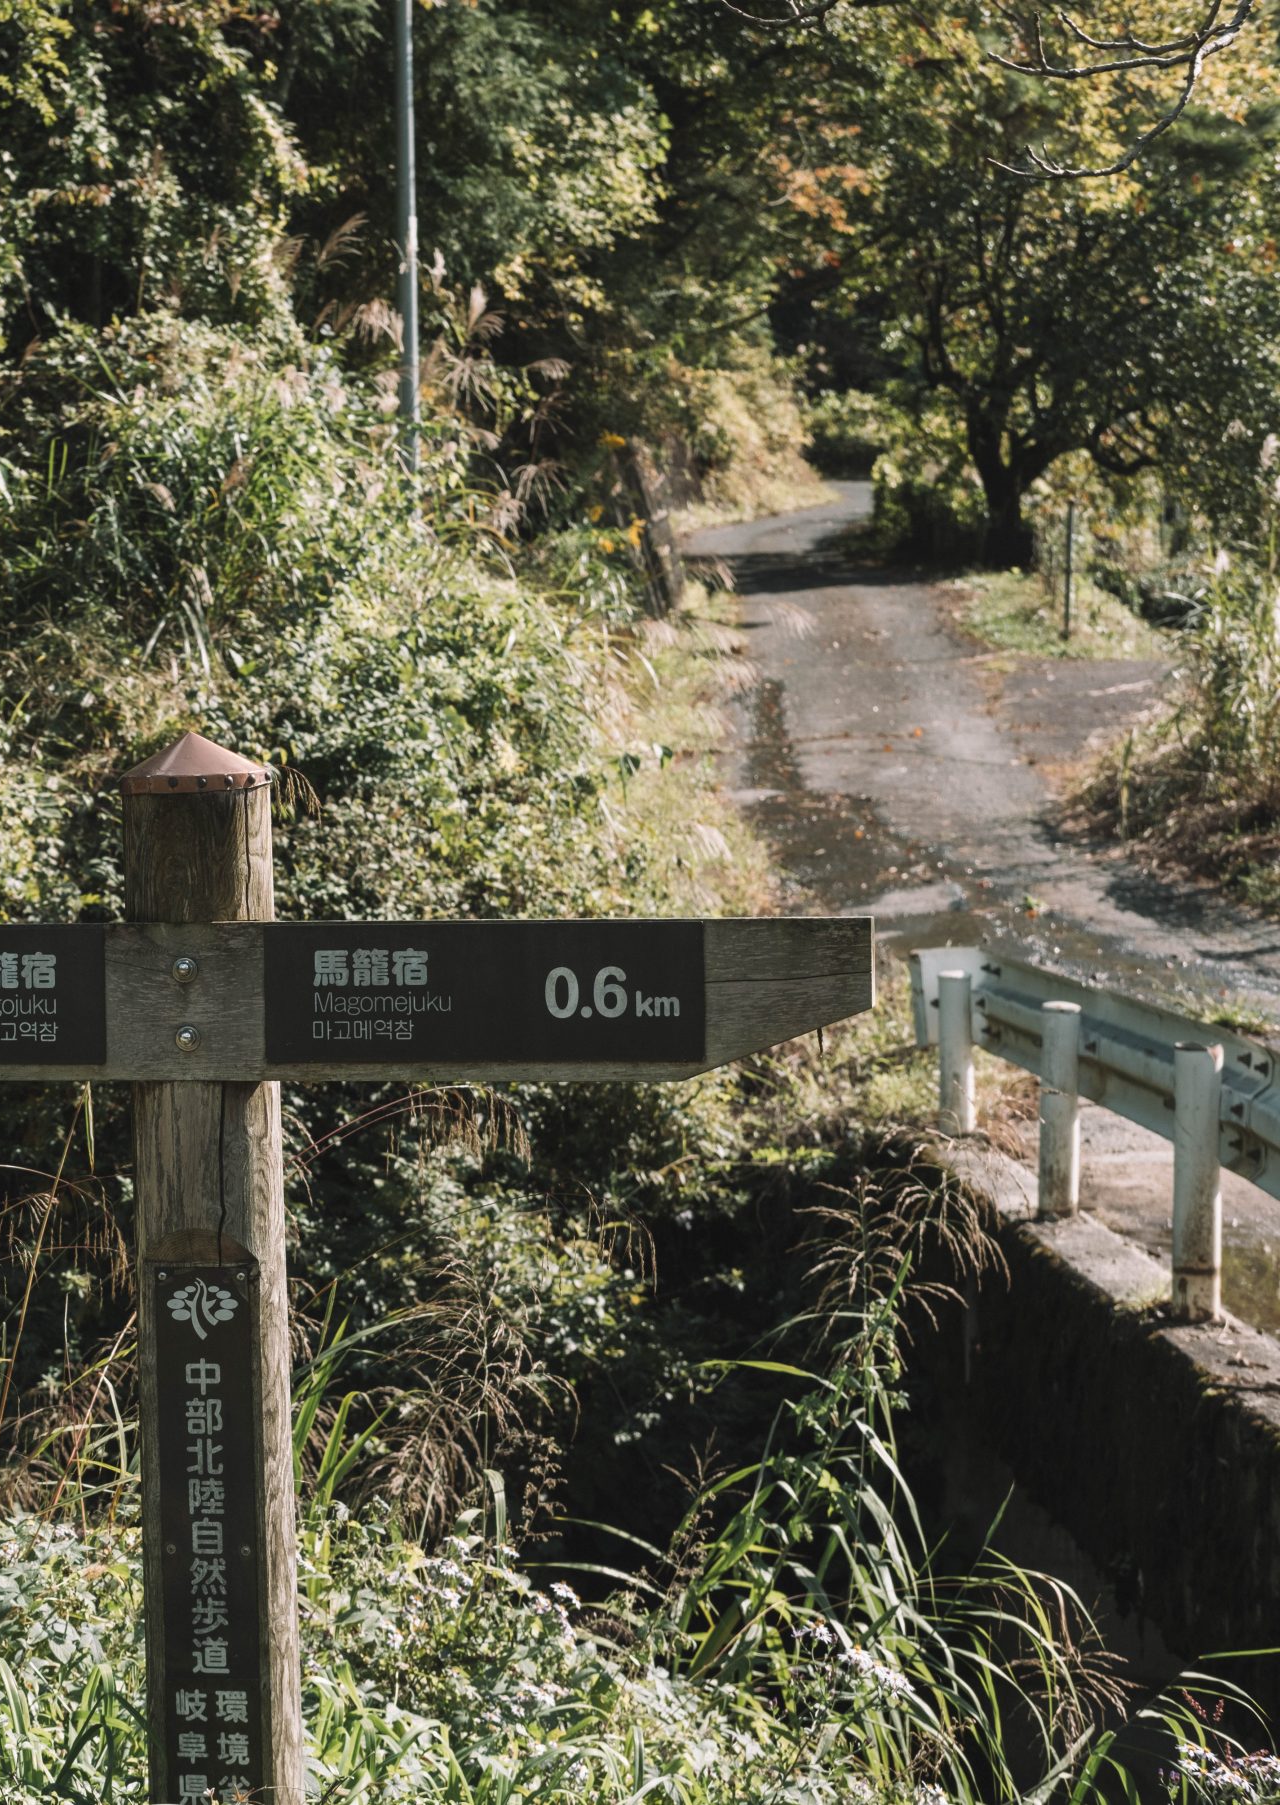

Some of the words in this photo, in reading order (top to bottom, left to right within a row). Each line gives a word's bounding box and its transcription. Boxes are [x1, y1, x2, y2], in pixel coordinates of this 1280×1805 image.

[312, 948, 429, 988] 馬籠宿
[313, 991, 453, 1017] Magomejuku
[543, 965, 628, 1019] 0.6
[635, 990, 681, 1017] km
[312, 1019, 415, 1041] 마고메역참
[185, 1357, 231, 1675] 中部北陸自然歩道
